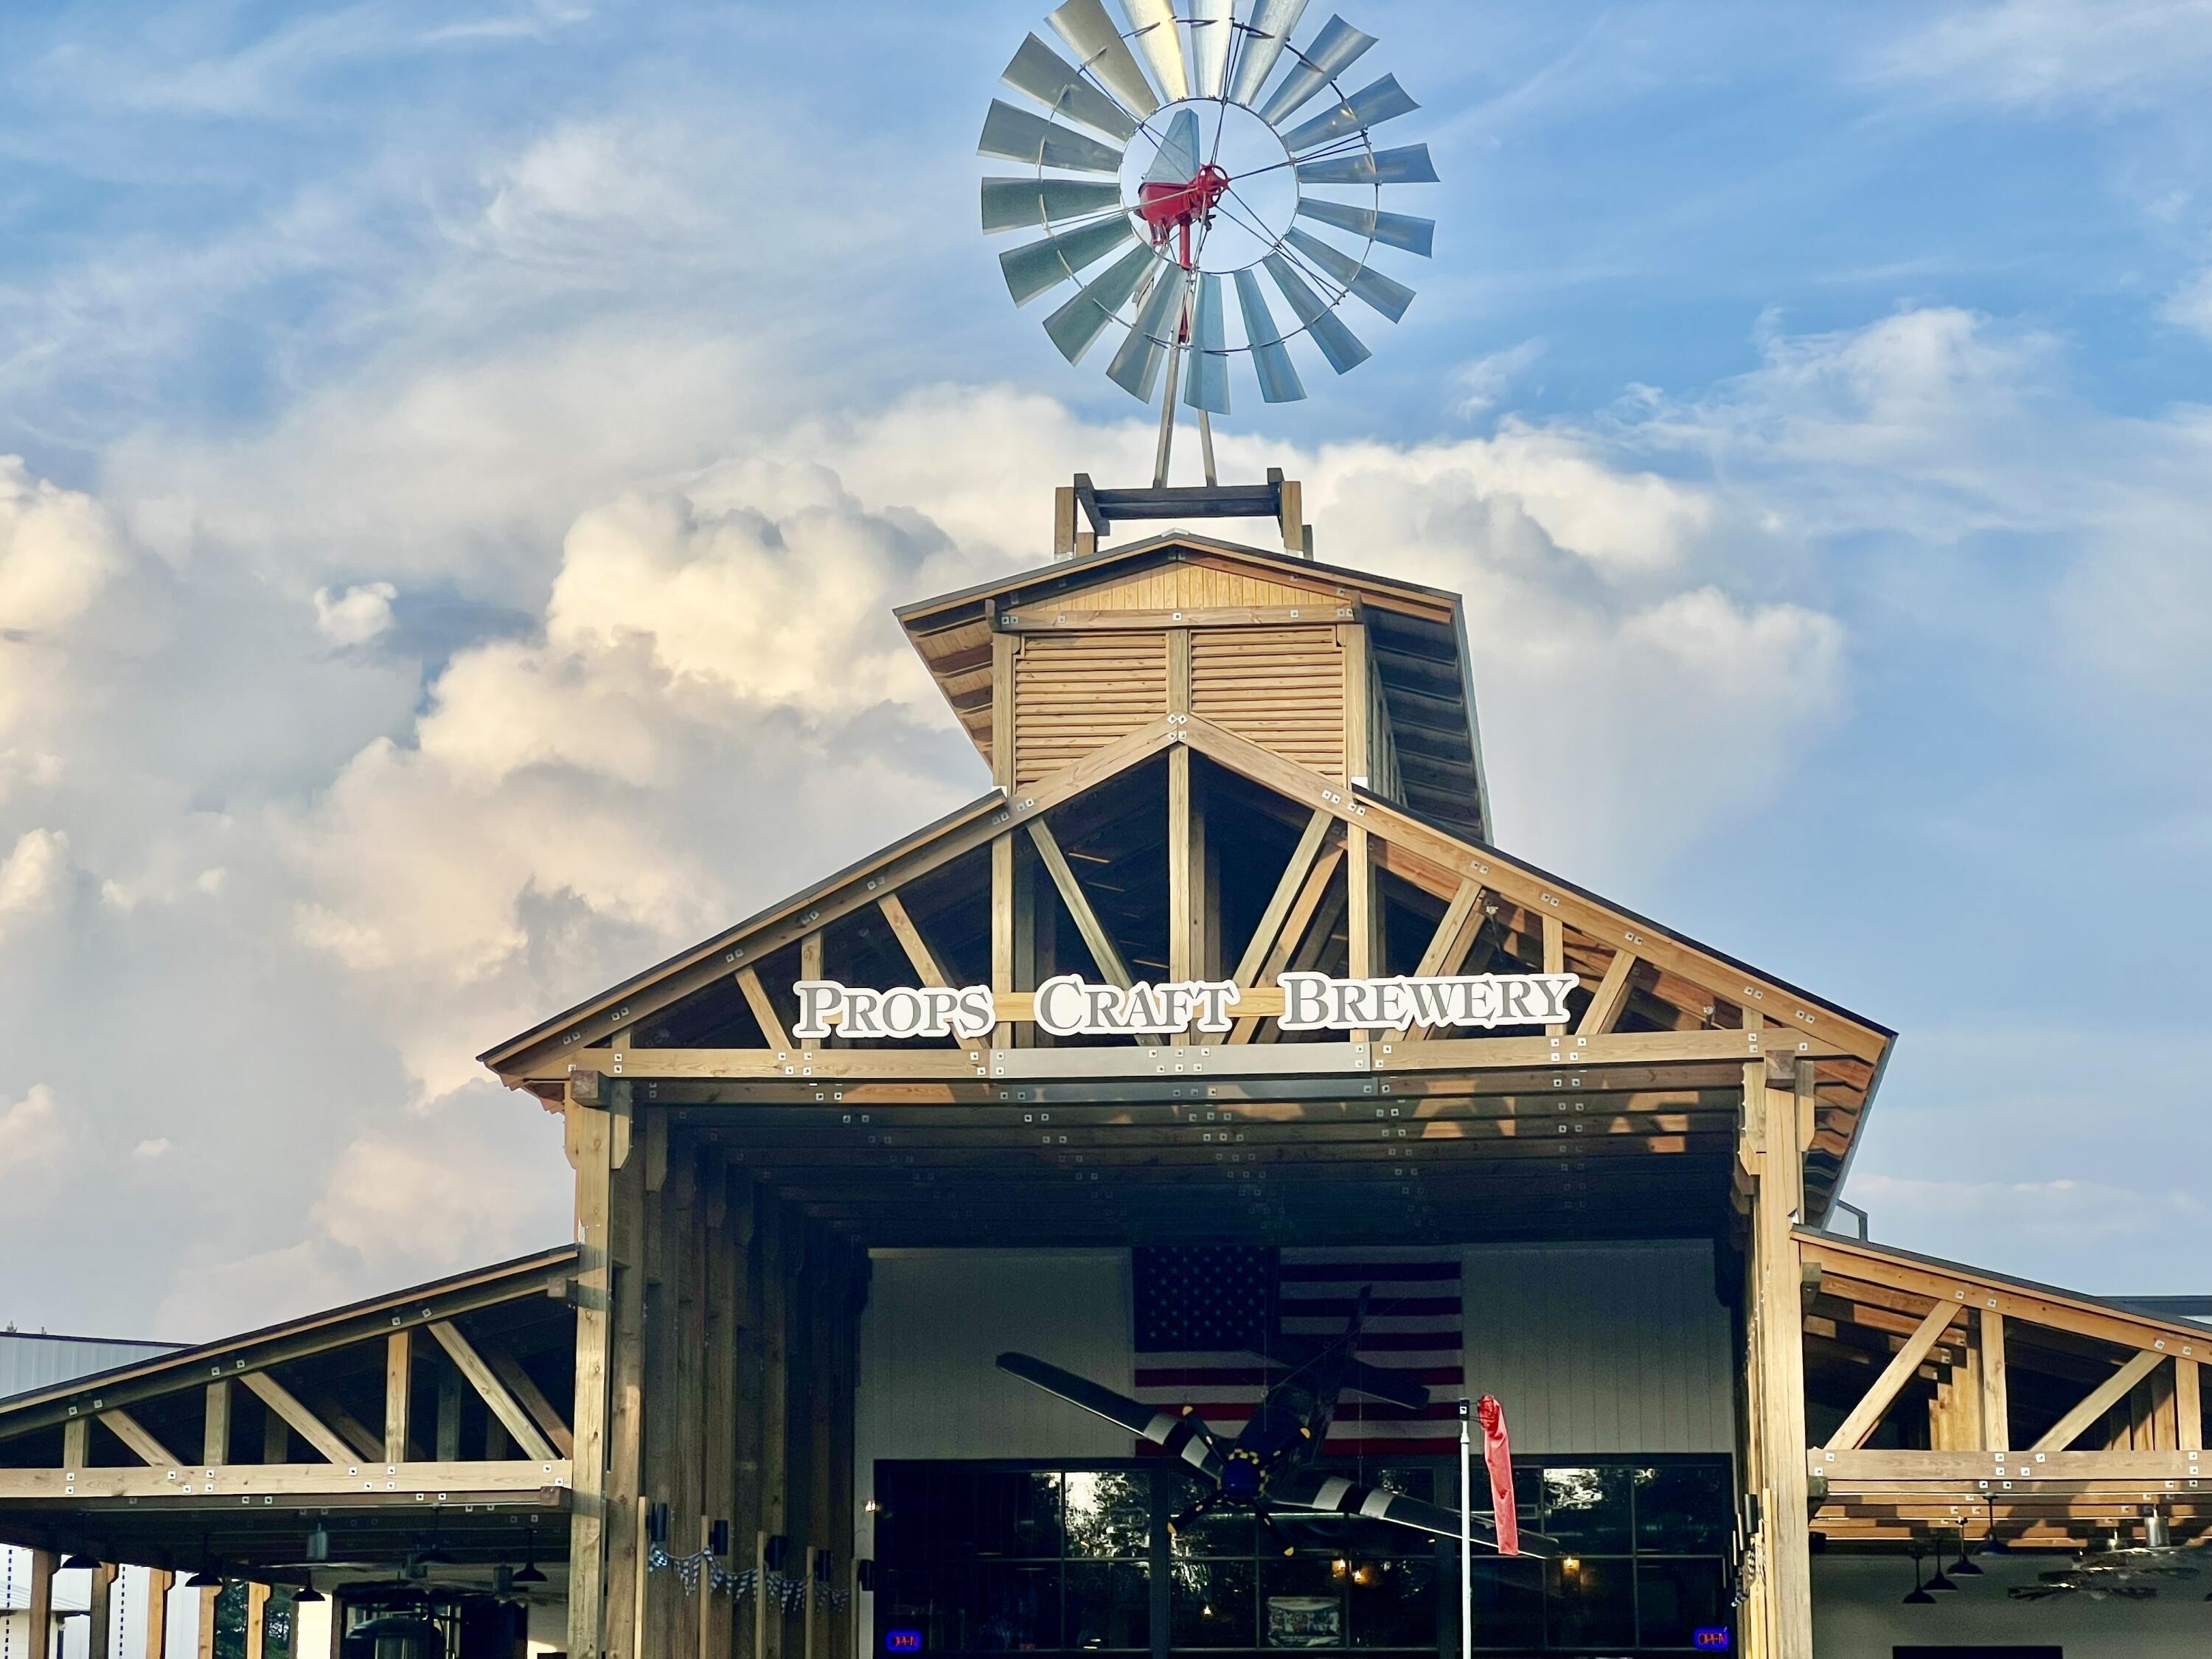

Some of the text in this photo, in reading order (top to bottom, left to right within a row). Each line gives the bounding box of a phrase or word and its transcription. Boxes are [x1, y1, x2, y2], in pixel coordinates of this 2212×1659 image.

[799, 978, 1573, 1032] PROPS CRAFT BREWERY
[1698, 1632, 1726, 1645] OPEN
